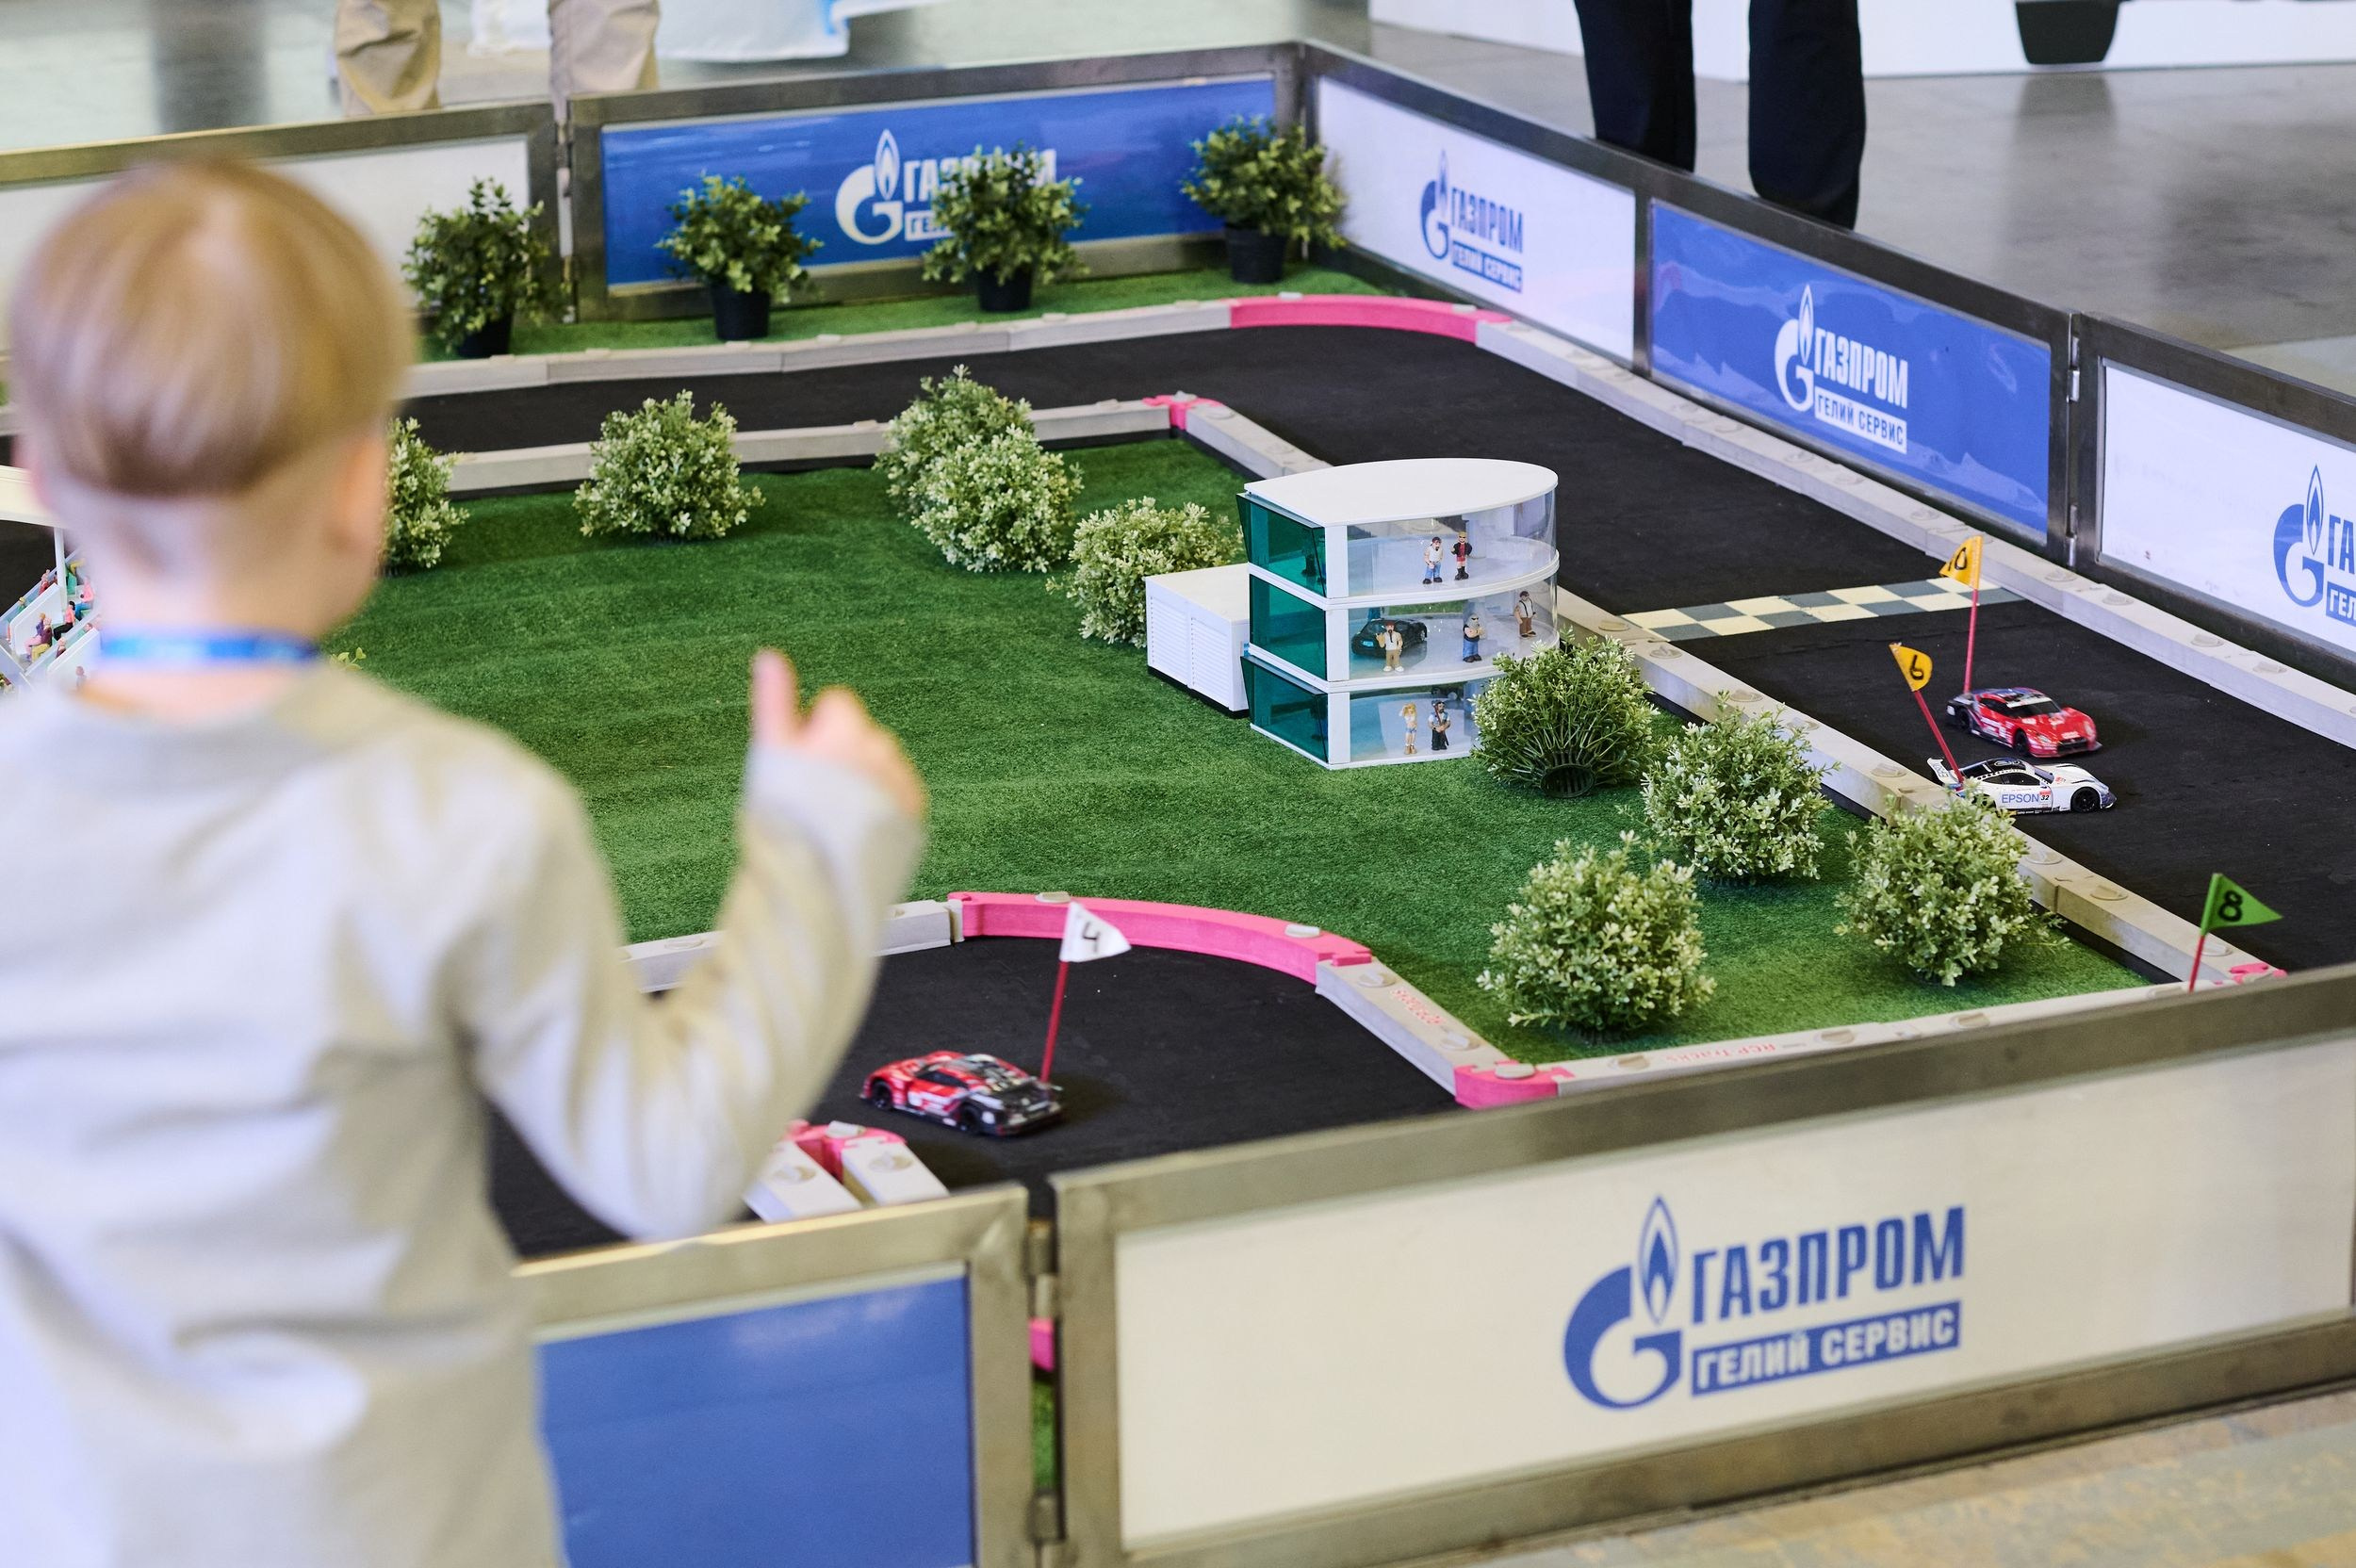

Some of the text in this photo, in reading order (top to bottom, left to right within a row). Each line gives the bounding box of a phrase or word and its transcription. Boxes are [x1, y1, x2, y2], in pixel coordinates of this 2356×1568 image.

[1451, 187, 1523, 253] ГАЗПРОМ
[1815, 327, 1908, 409] ГАЗПРОМ
[1817, 394, 1904, 446] ГЕЛИЙ СЕРВИС
[1909, 654, 1924, 680] 6
[2002, 793, 2039, 804] EPSON
[2218, 890, 2243, 922] 8
[1081, 922, 1101, 953] 4
[1693, 1206, 1964, 1324] ГАЗПРОМ
[1696, 1307, 1955, 1391] ГЕЛИЙ СЕРВИС
